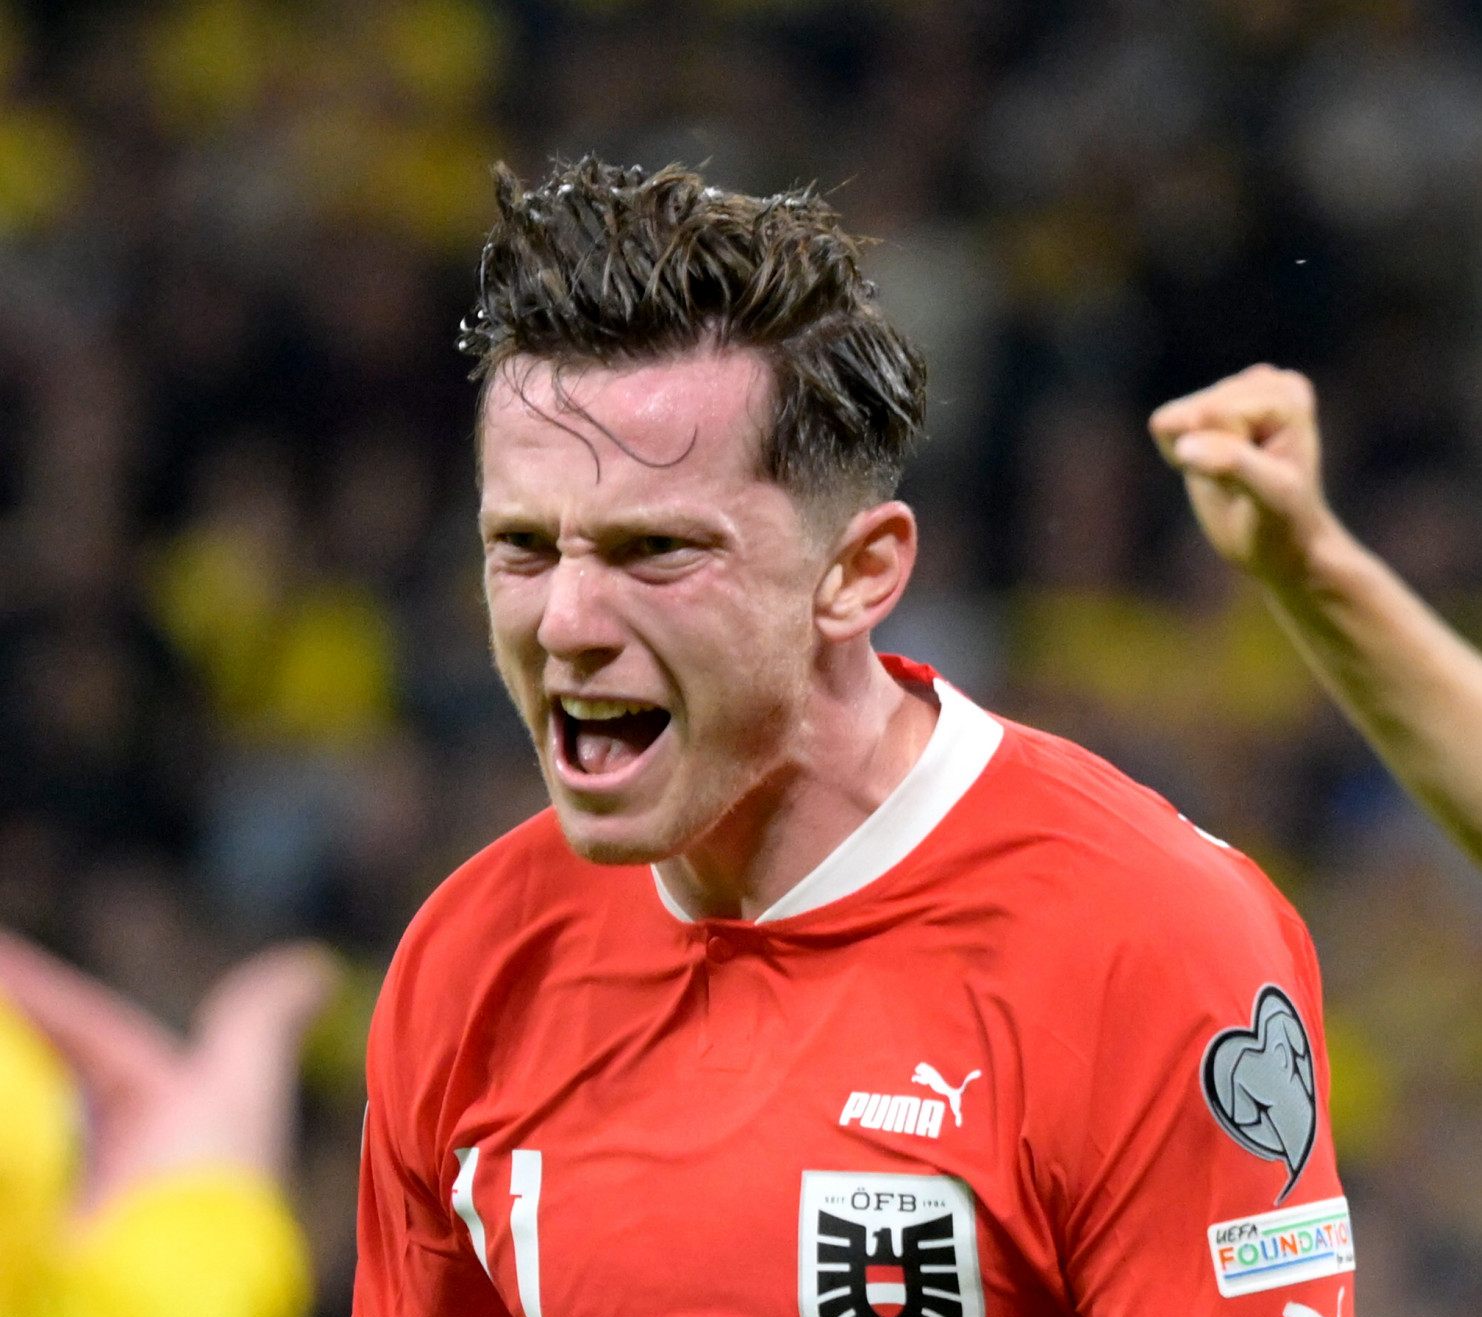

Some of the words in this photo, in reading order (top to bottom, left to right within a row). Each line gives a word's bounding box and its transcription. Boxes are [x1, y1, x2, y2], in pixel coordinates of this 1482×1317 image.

[839, 1091, 945, 1139] PUMA
[851, 1186, 917, 1213] ÖFB
[1216, 1223, 1258, 1245] UEFA
[1218, 1224, 1351, 1271] FOUNDATIO
